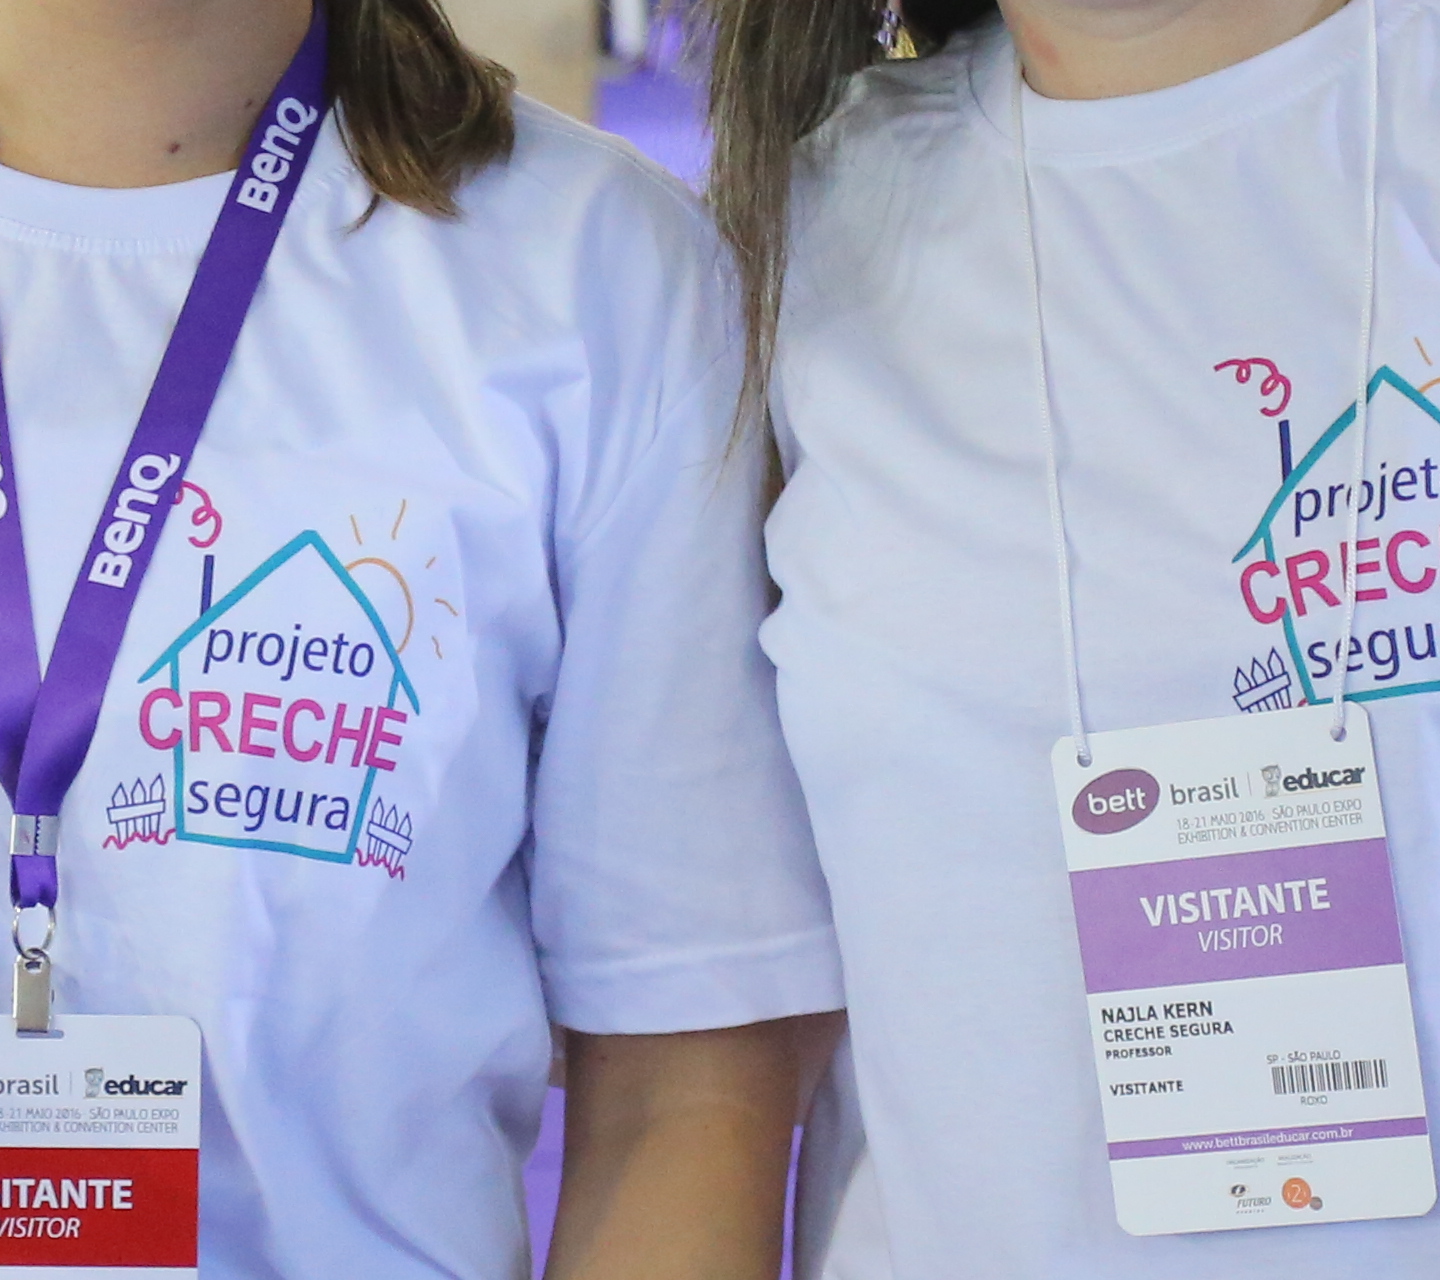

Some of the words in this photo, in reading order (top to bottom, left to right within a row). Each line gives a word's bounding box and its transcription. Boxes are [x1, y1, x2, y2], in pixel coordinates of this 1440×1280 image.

[237, 96, 318, 214] BenQ
[87, 453, 180, 588] BenQ
[202, 623, 375, 681] projeto
[139, 687, 407, 772] CRECHE
[1087, 788, 1147, 815] bett
[1170, 777, 1240, 806] brasil
[1283, 765, 1366, 792] educar
[187, 778, 350, 832] segura
[1210, 813, 1236, 828] MAIO
[1240, 809, 1265, 824] 2016
[1272, 804, 1294, 820] SÃO
[1297, 802, 1330, 817] PAULO
[1333, 799, 1362, 813] EXPO
[1178, 827, 1237, 844] EXHIBITION
[1240, 826, 1247, 837] &
[1250, 818, 1319, 837] CONVENTION
[1321, 812, 1363, 828] CENTER
[1139, 877, 1331, 927] VISITANTE
[1198, 923, 1283, 952] VISITOR
[1101, 1005, 1158, 1024] NAJLA
[1163, 1001, 1213, 1020] KERN
[1103, 1025, 1166, 1043] CRECHE
[1170, 1021, 1234, 1038] SEGURA
[1105, 1046, 1173, 1060] PROFESSOR
[1310, 1050, 1341, 1061] PAULO
[104, 1074, 188, 1096] educar
[1109, 1080, 1184, 1096] VISITANTE
[25, 1108, 53, 1120] MAIO
[113, 1109, 148, 1120] PAULO
[151, 1109, 180, 1120] EXPO
[64, 1121, 134, 1133] CONVENTION
[137, 1122, 178, 1133] CENTER
[1182, 1126, 1354, 1152] www.bettbrasileducar.com.br
